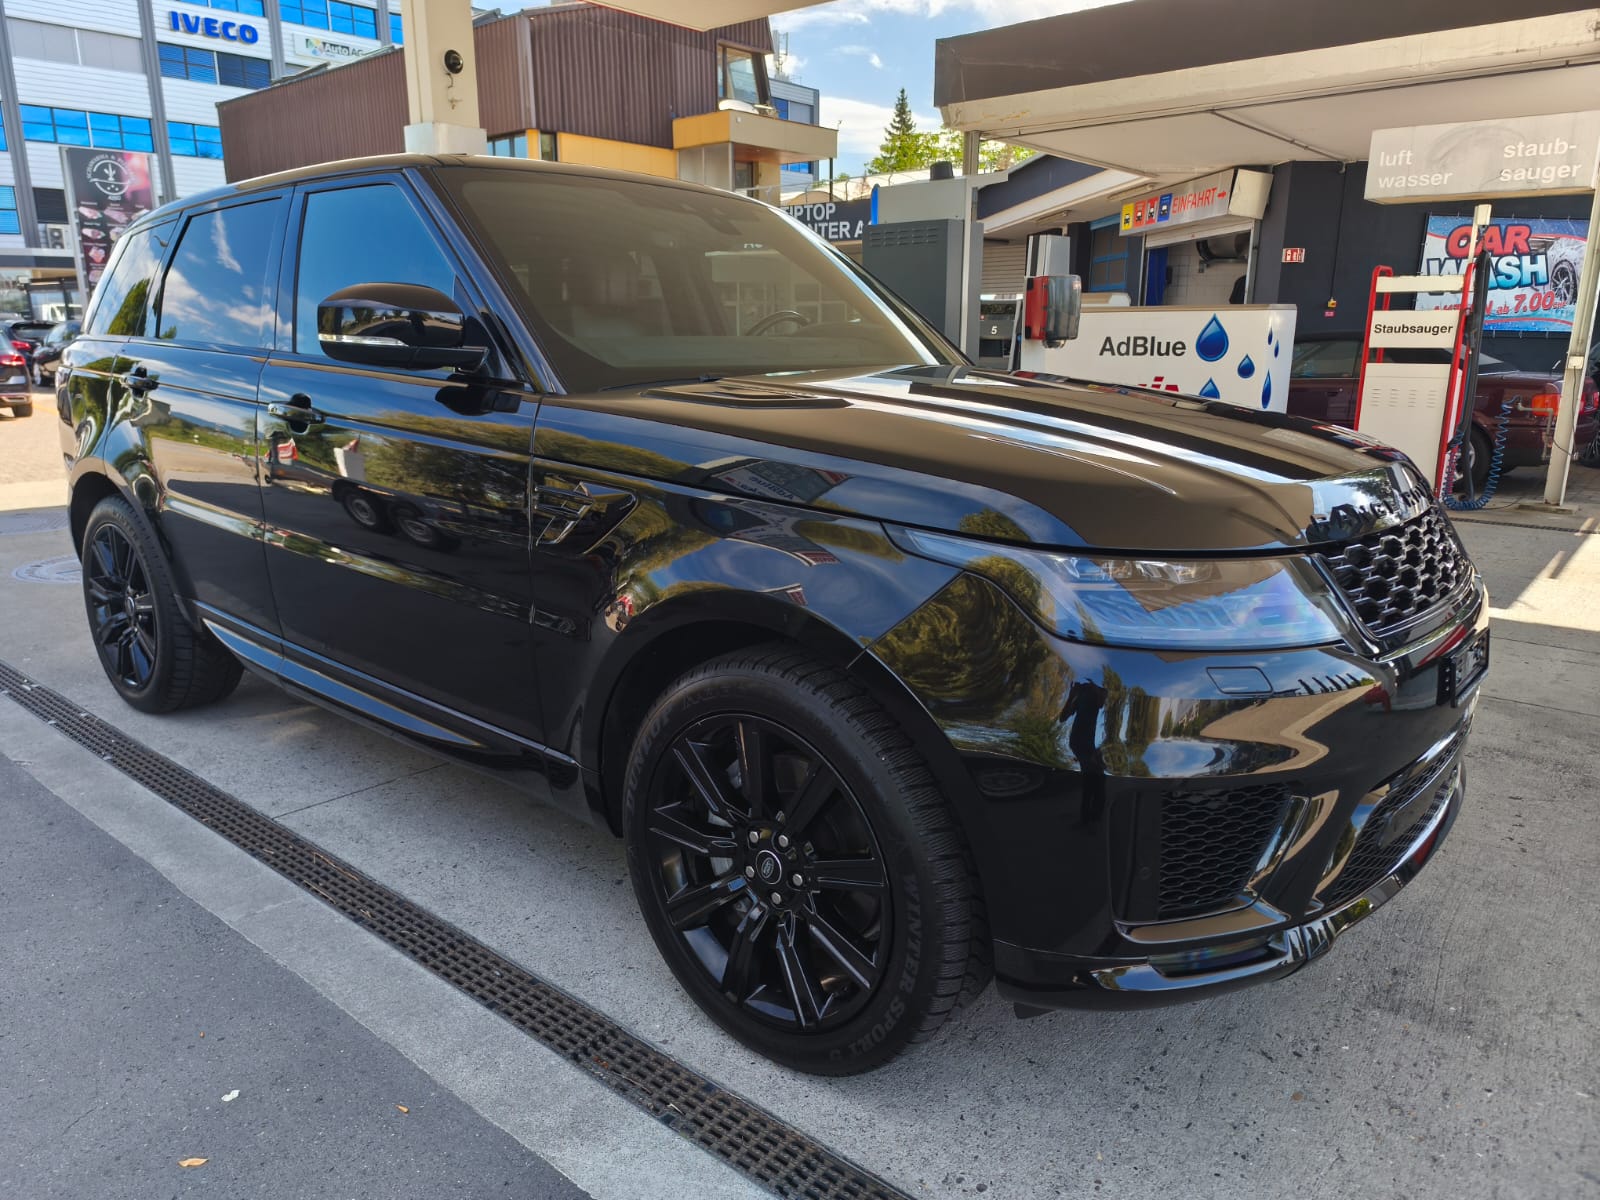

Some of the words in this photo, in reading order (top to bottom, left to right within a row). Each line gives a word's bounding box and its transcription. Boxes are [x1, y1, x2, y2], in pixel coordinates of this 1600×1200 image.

[170, 11, 258, 44] IVECO
[1379, 150, 1413, 167] luft
[1503, 137, 1577, 158] staub-
[1378, 171, 1453, 189] wasser
[1499, 163, 1583, 184] sauger
[1172, 188, 1217, 214] EINFAHRT
[807, 221, 851, 240] NTER
[854, 220, 873, 239] A
[1446, 224, 1531, 258] CAR
[1514, 291, 1554, 313] 7.00
[991, 325, 998, 335] 5
[1374, 323, 1453, 336] Staubsauger
[1099, 336, 1187, 357] AdBlue
[898, 872, 922, 994] WINTER
[847, 995, 906, 1058] SPORT
